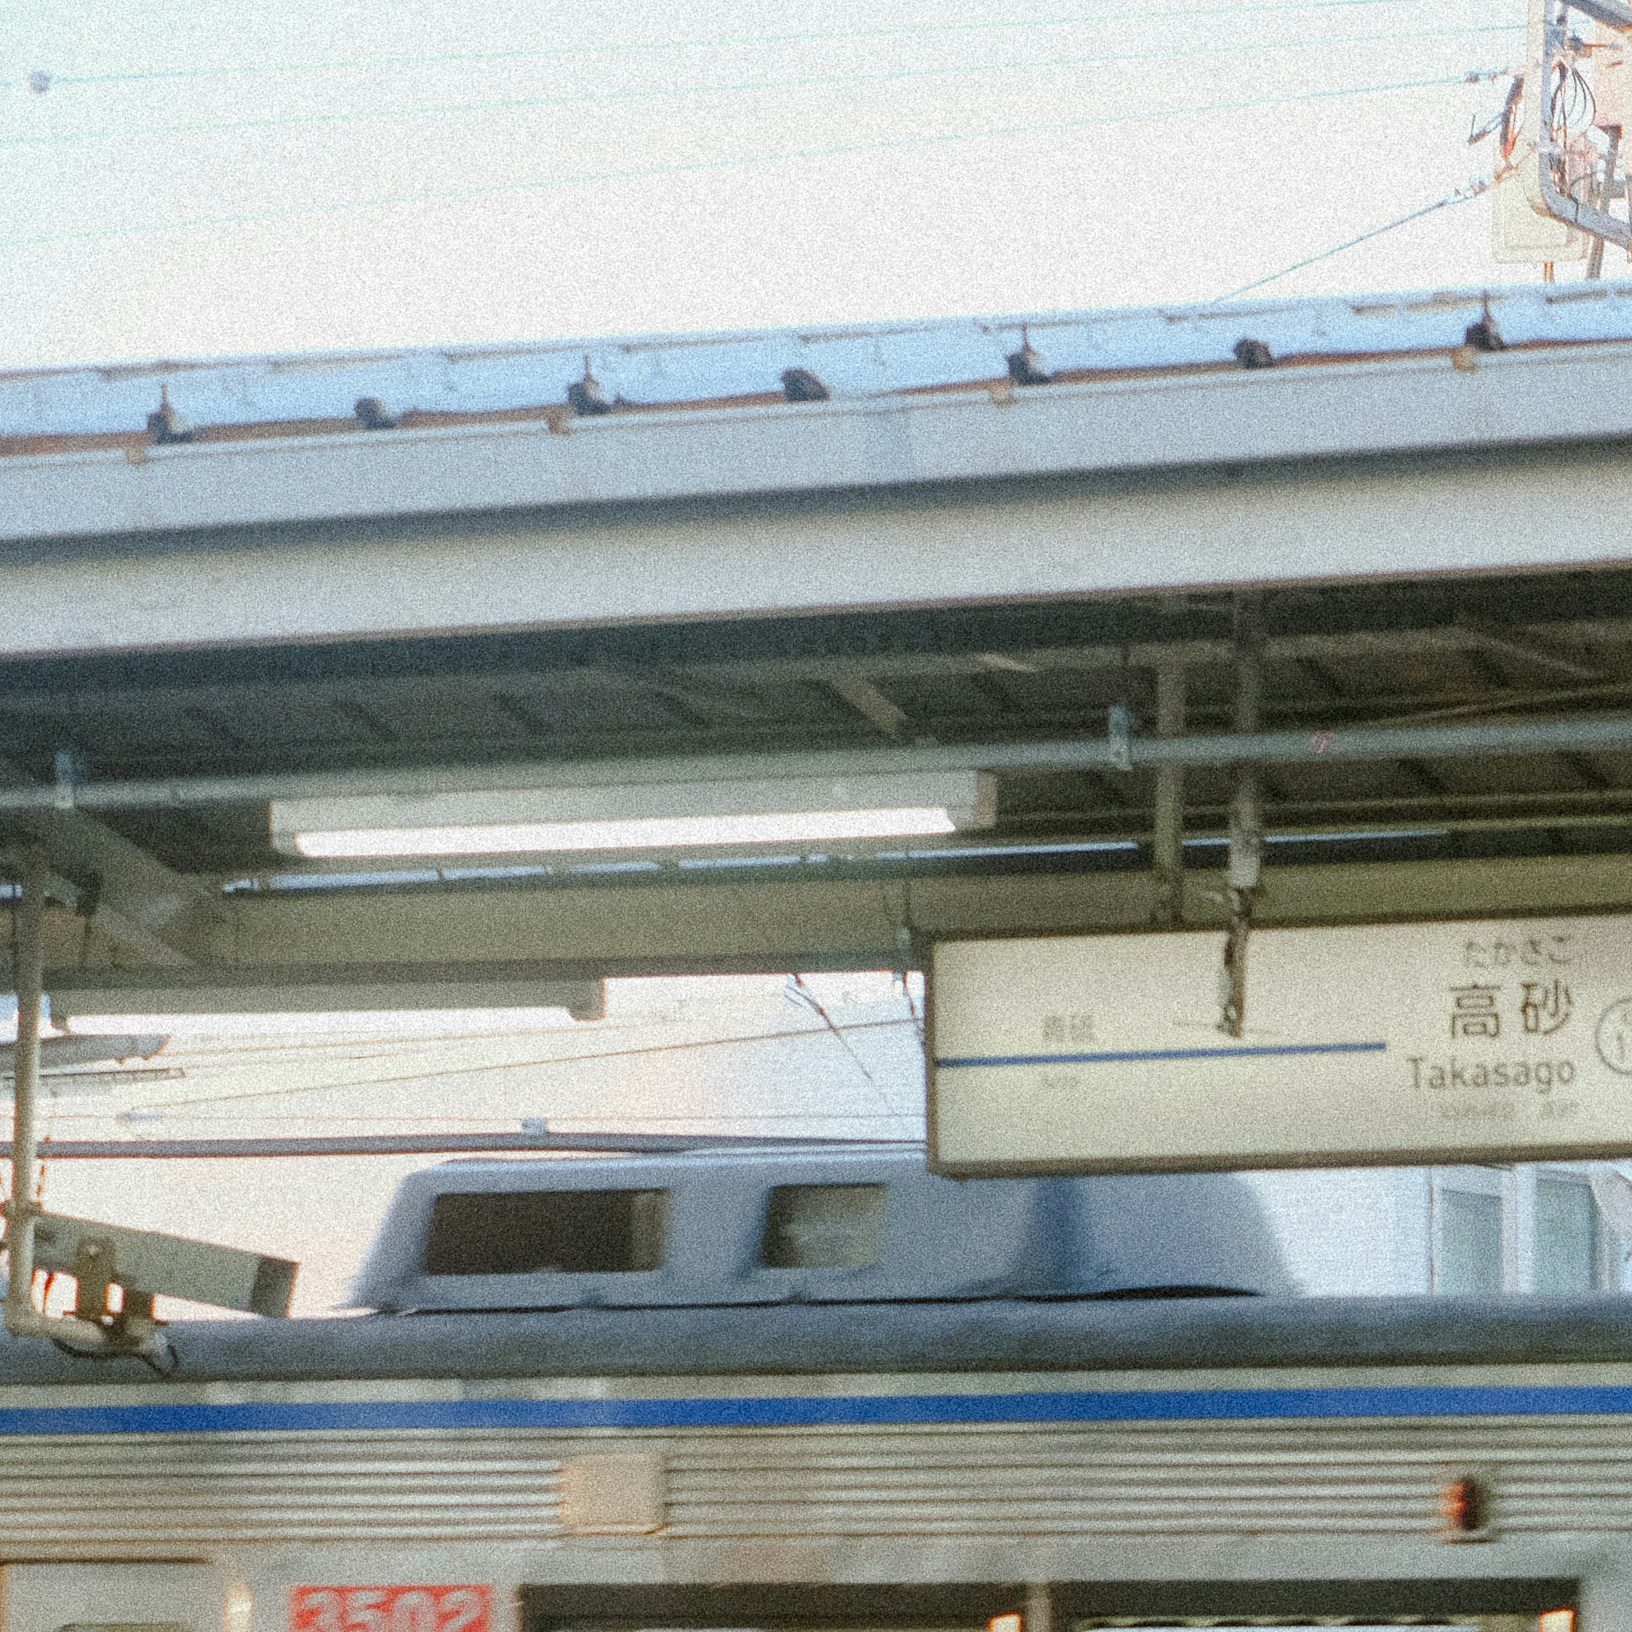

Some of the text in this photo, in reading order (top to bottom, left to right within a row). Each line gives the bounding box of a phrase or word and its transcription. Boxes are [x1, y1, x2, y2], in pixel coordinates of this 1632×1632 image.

[1463, 934, 1575, 969] たかさご
[1448, 977, 1575, 1040] 高砂
[1405, 1055, 1577, 1096] Takasago
